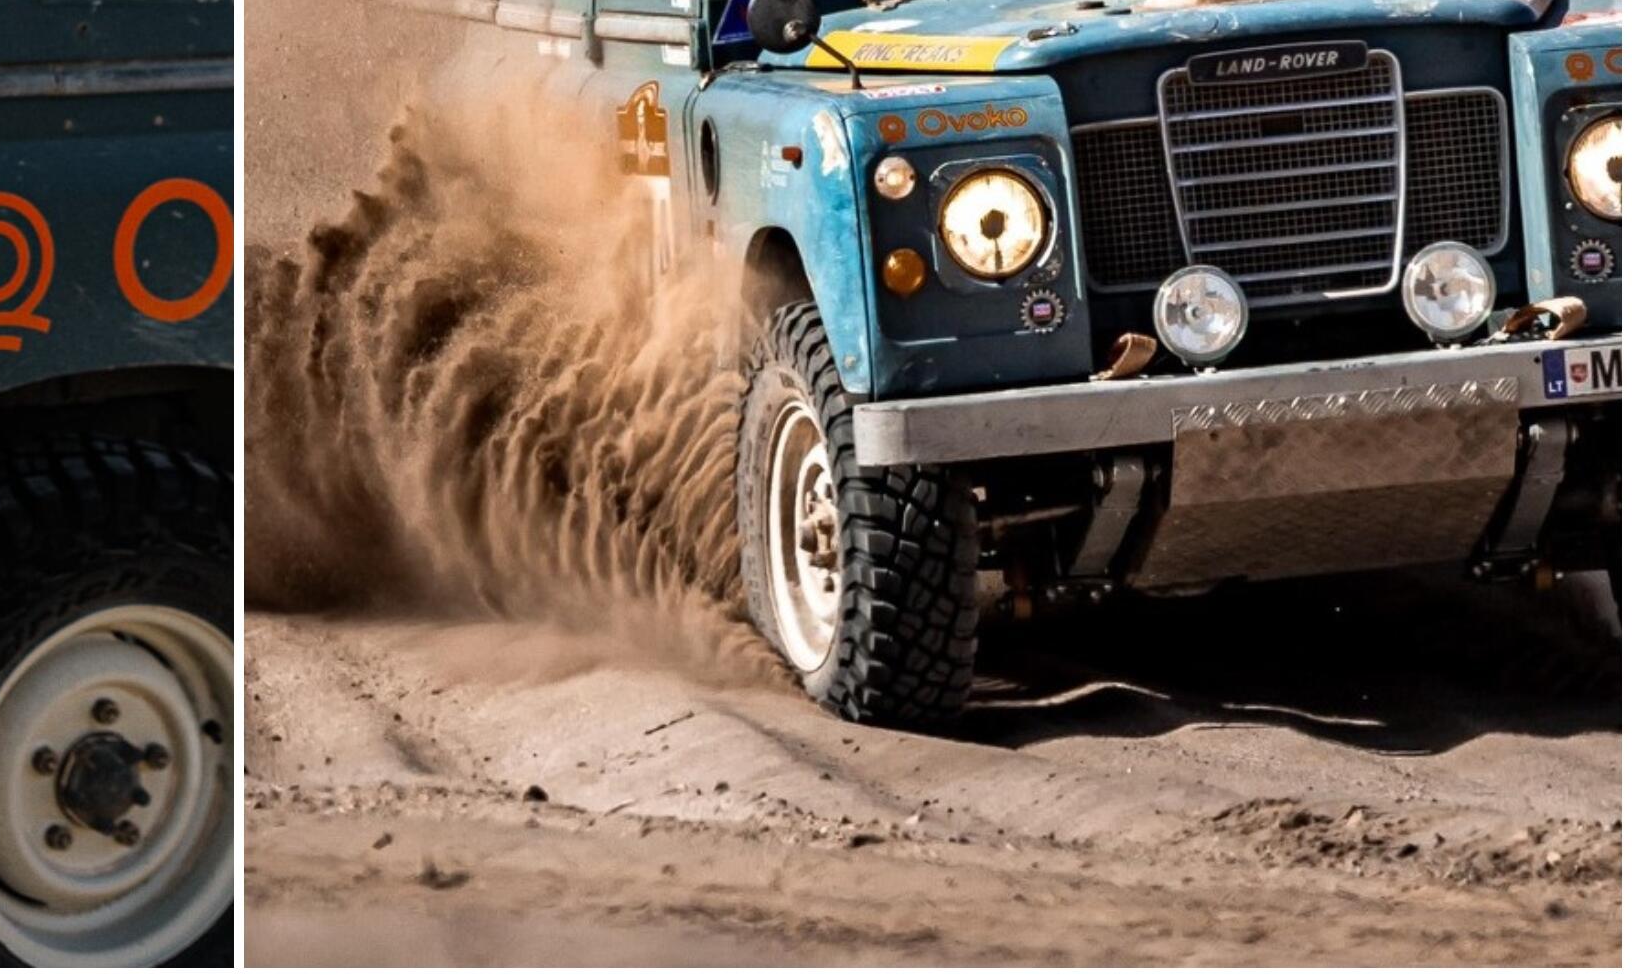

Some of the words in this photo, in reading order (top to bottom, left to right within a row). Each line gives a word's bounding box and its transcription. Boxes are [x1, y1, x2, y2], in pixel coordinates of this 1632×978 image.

[1216, 50, 1339, 76] LAND-ROVER
[917, 104, 1029, 138] Ovoko
[1549, 380, 1564, 393] LT
[1591, 349, 1622, 389] M
